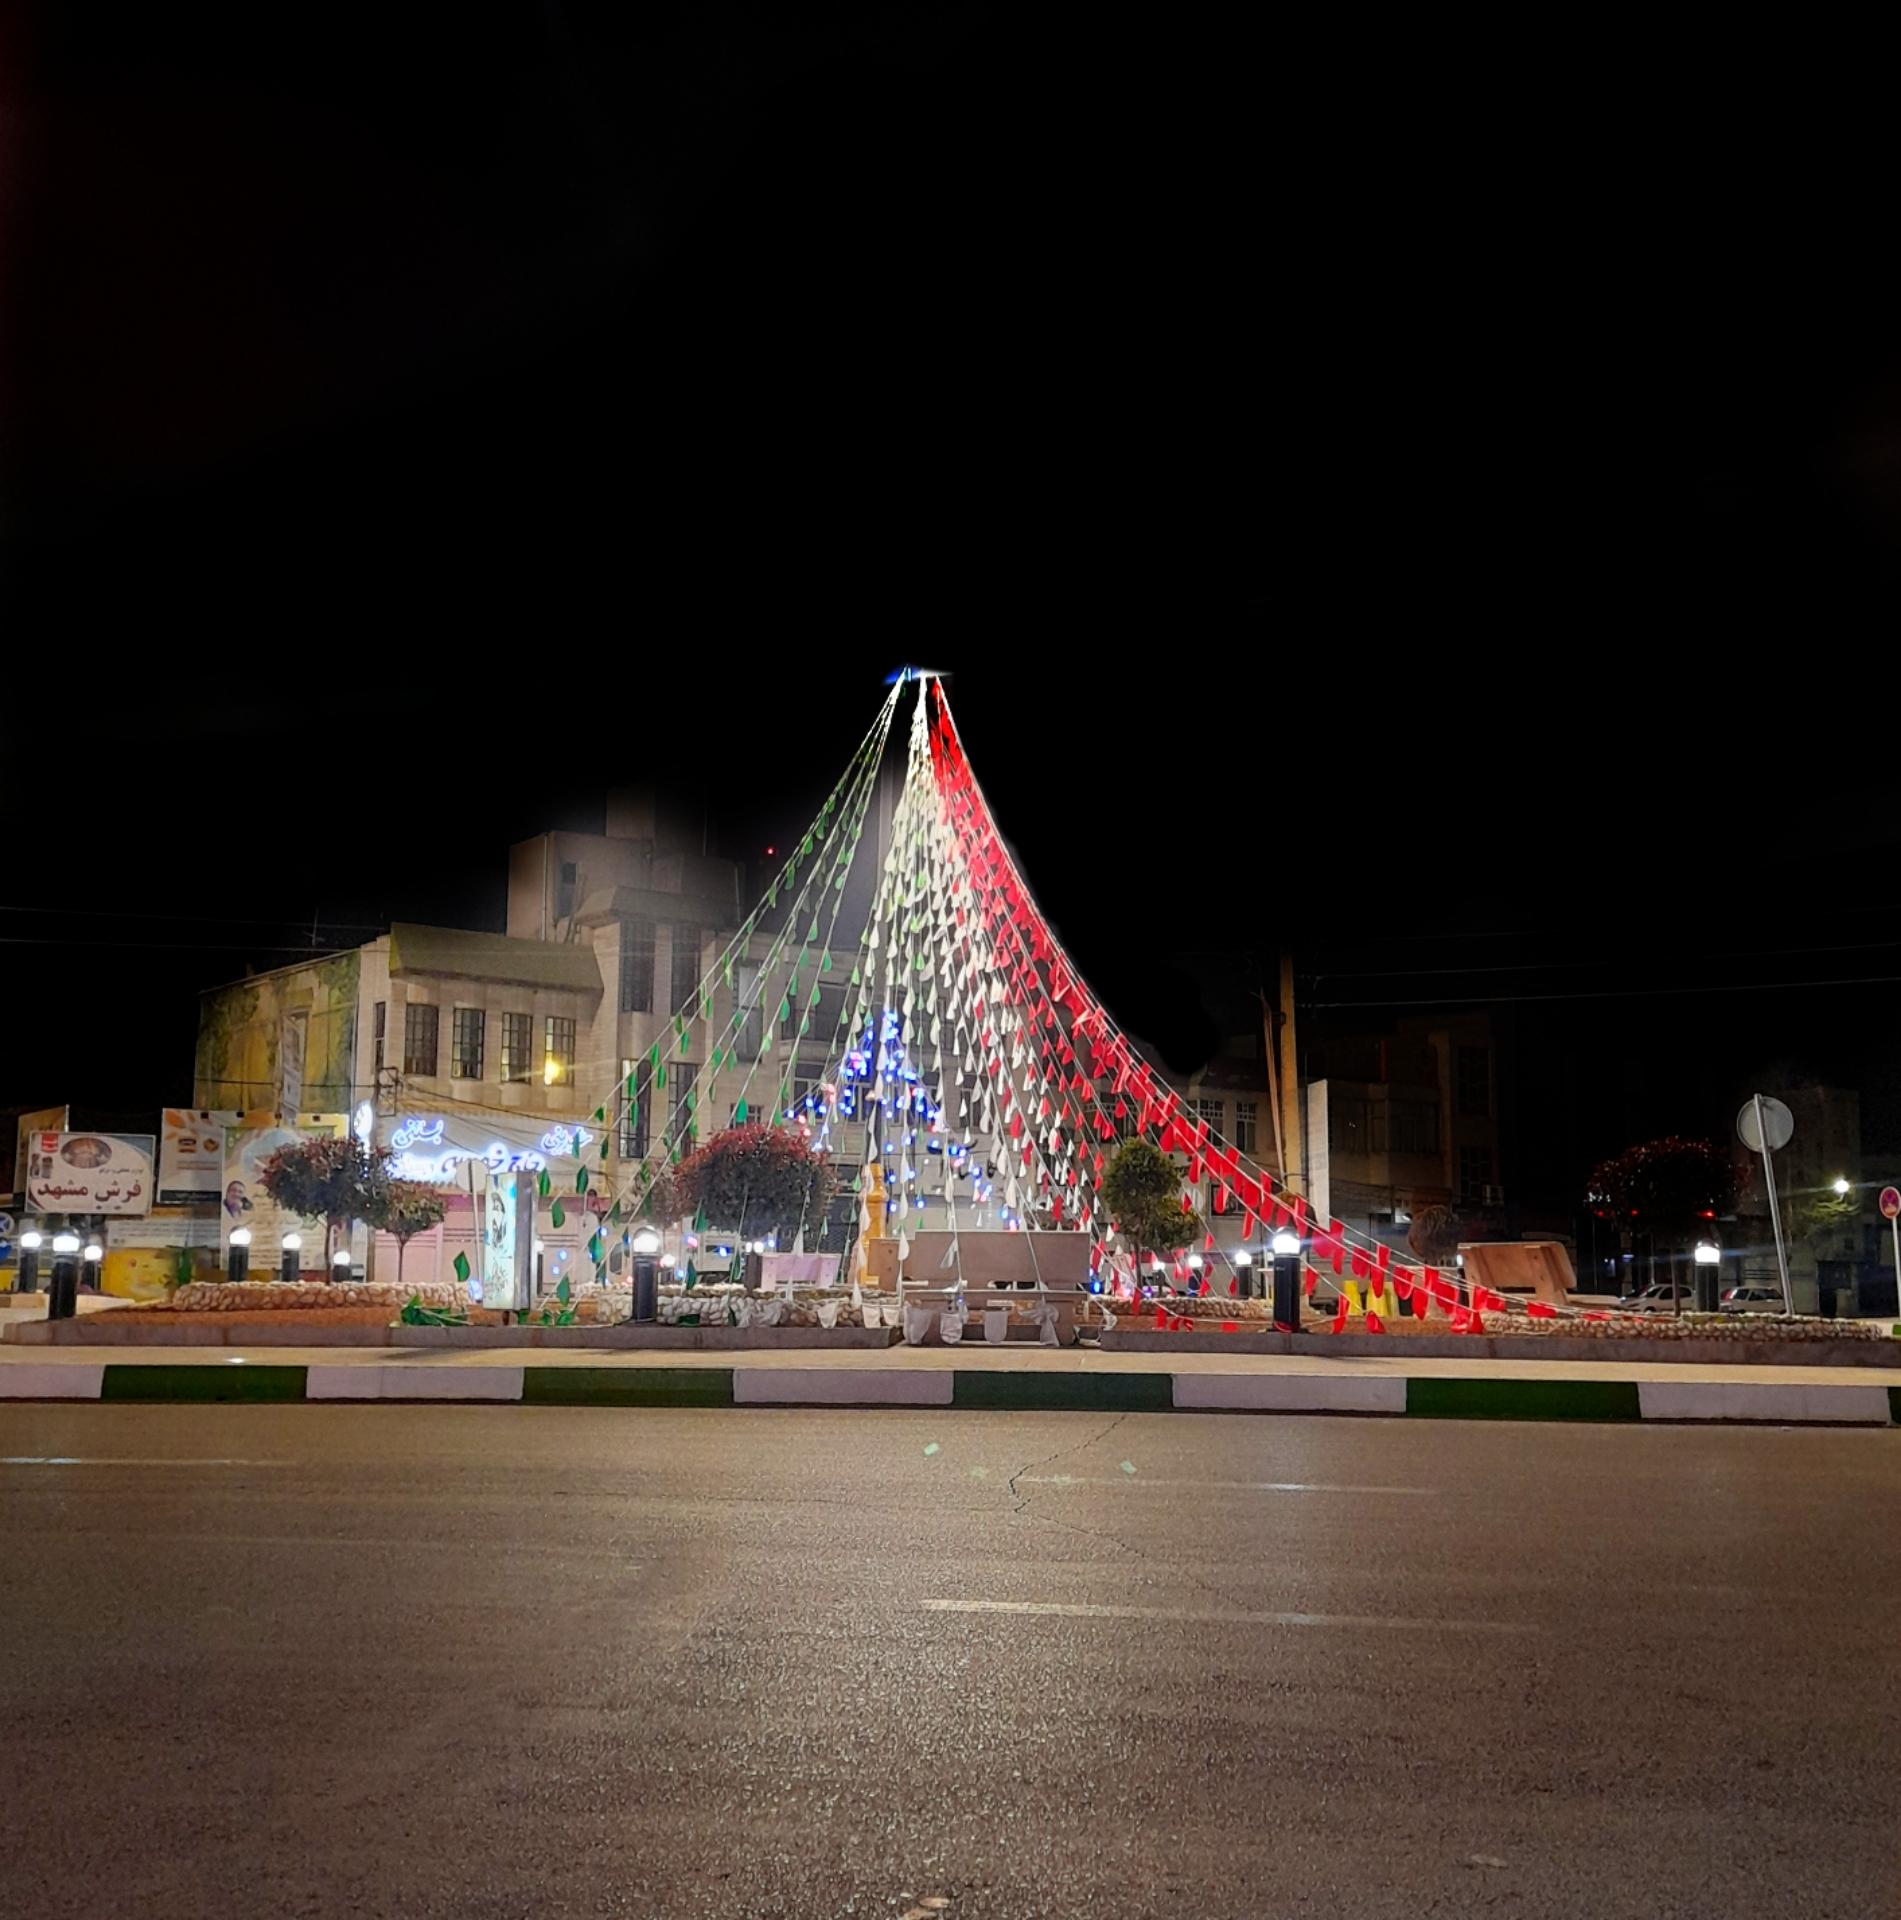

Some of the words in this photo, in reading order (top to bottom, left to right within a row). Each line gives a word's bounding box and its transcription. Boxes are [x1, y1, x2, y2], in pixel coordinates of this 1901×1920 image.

[391, 1119, 445, 1149] بستنی
[37, 1179, 89, 1200] مشهد
[94, 1179, 142, 1204] فرش
